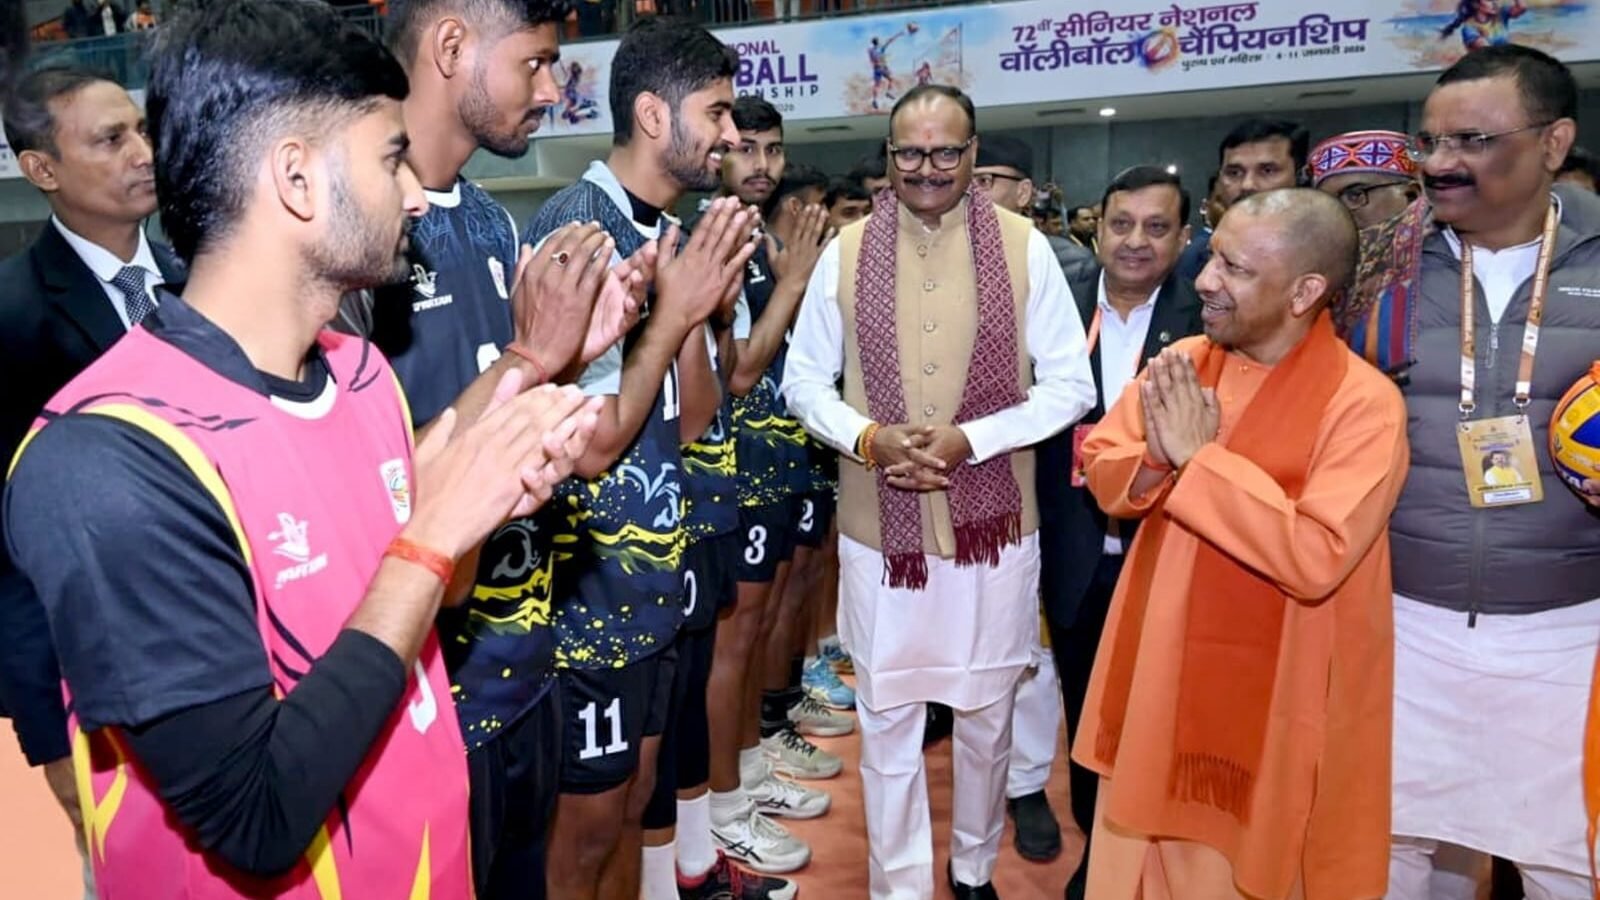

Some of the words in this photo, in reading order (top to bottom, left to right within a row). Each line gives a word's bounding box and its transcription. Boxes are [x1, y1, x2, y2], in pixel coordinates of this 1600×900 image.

[1054, 10, 1153, 39] सीनियर
[1158, 1, 1260, 28] नेशनल
[736, 53, 818, 87] BALL
[1000, 37, 1137, 72] वॉलीबॉल
[744, 525, 768, 565] 3
[578, 697, 629, 760] 11
